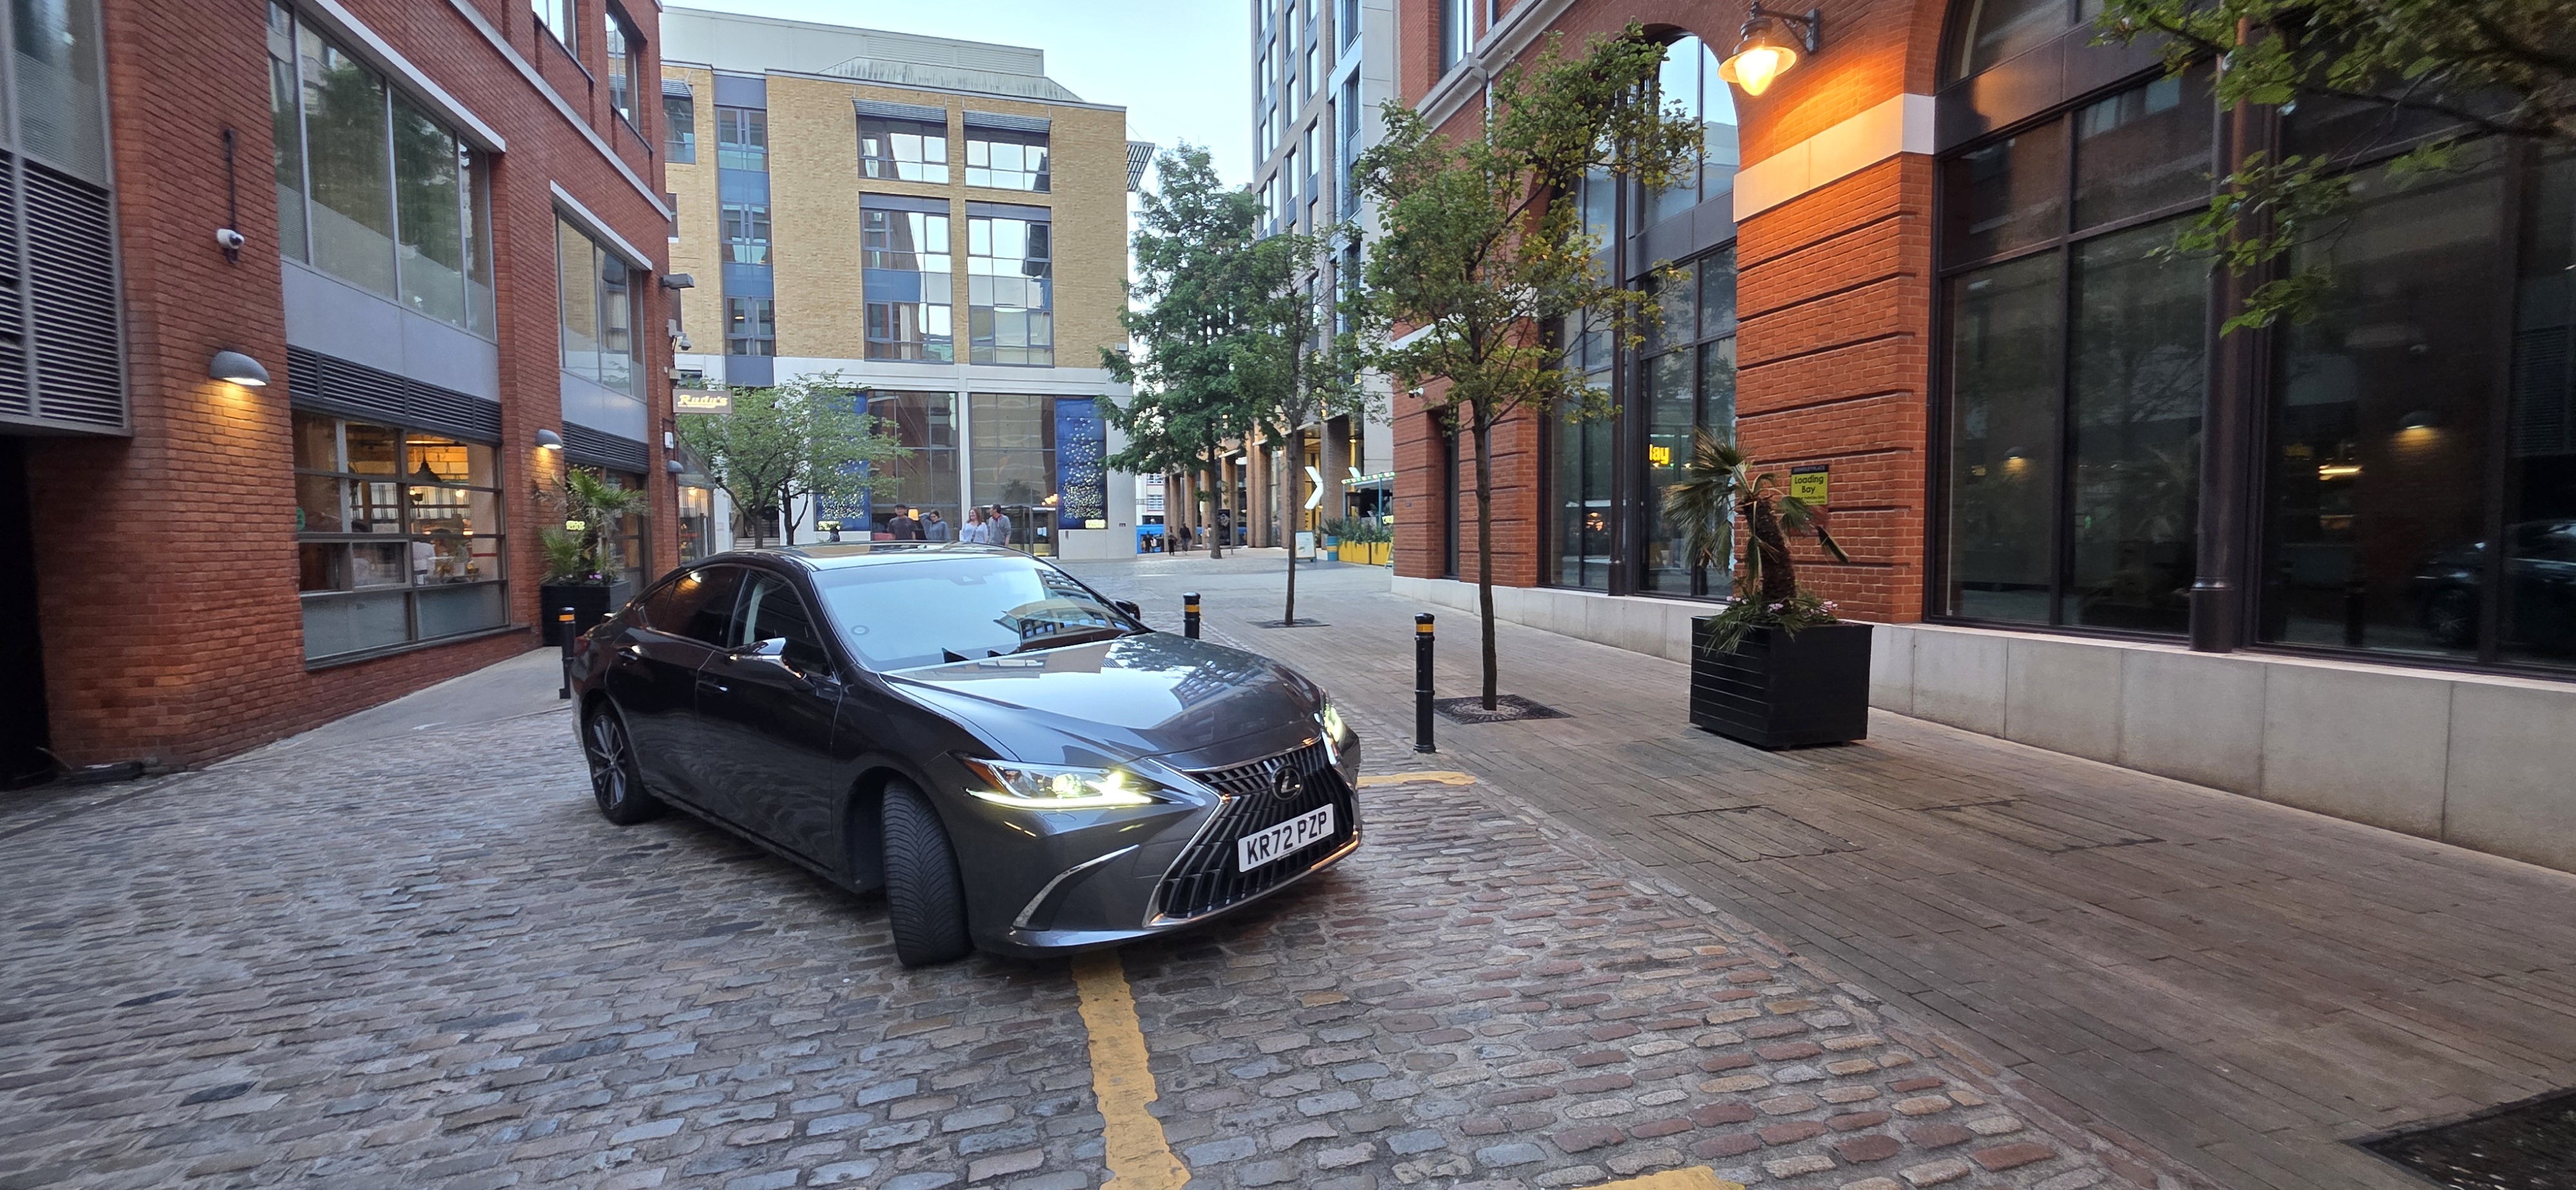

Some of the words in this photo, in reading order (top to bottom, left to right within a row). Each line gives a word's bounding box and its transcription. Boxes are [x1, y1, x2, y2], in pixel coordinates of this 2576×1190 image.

[677, 395, 728, 408] Rudy's
[1794, 475, 1824, 484] Loading
[1801, 486, 1815, 495] Bay
[1247, 826, 1293, 864] KR72
[1297, 811, 1327, 844] PZP
